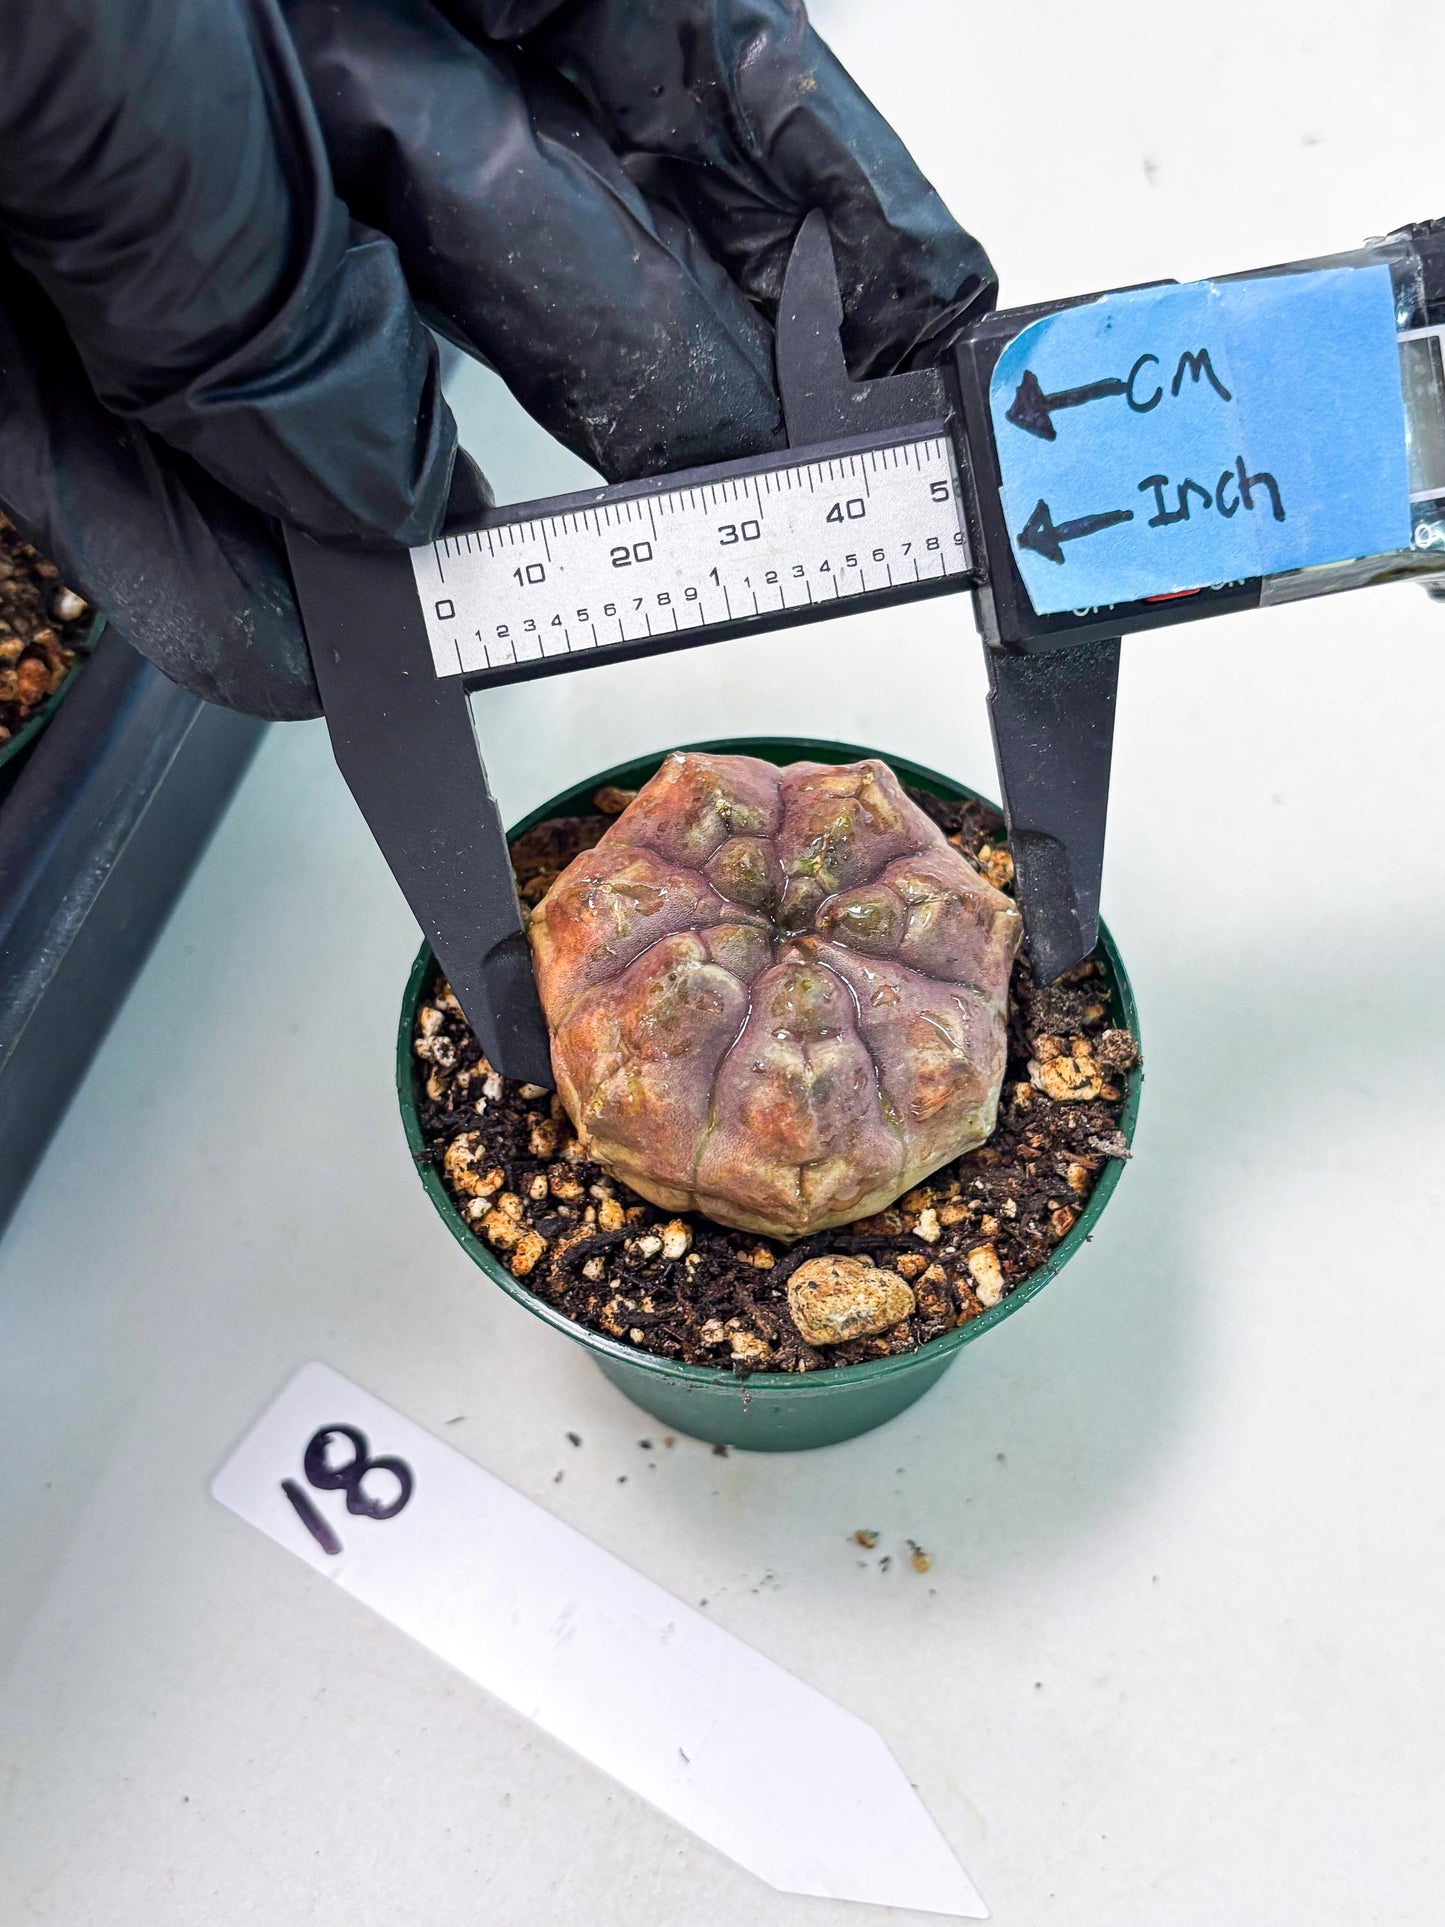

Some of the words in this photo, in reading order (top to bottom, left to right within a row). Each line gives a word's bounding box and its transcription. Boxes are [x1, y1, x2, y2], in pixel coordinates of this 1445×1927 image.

[1138, 455, 1286, 527] Inch
[433, 599, 456, 621] 0
[512, 561, 547, 587] 10
[609, 540, 654, 568] 20
[717, 519, 761, 546] 30
[825, 498, 866, 524] 40
[495, 624, 511, 637] 2
[523, 618, 537, 631] 3
[550, 614, 563, 627] 4
[576, 608, 590, 622] 5
[603, 603, 617, 617] 6
[632, 597, 643, 611] 7
[656, 592, 671, 605] 8
[684, 587, 697, 601] 9
[764, 570, 779, 584] 2
[792, 564, 805, 578] 3
[819, 559, 831, 573] 4
[845, 554, 858, 567] 5
[872, 548, 885, 562] 6
[902, 542, 912, 556] 7
[925, 537, 939, 550] 8
[280, 1422, 415, 1556] 18
